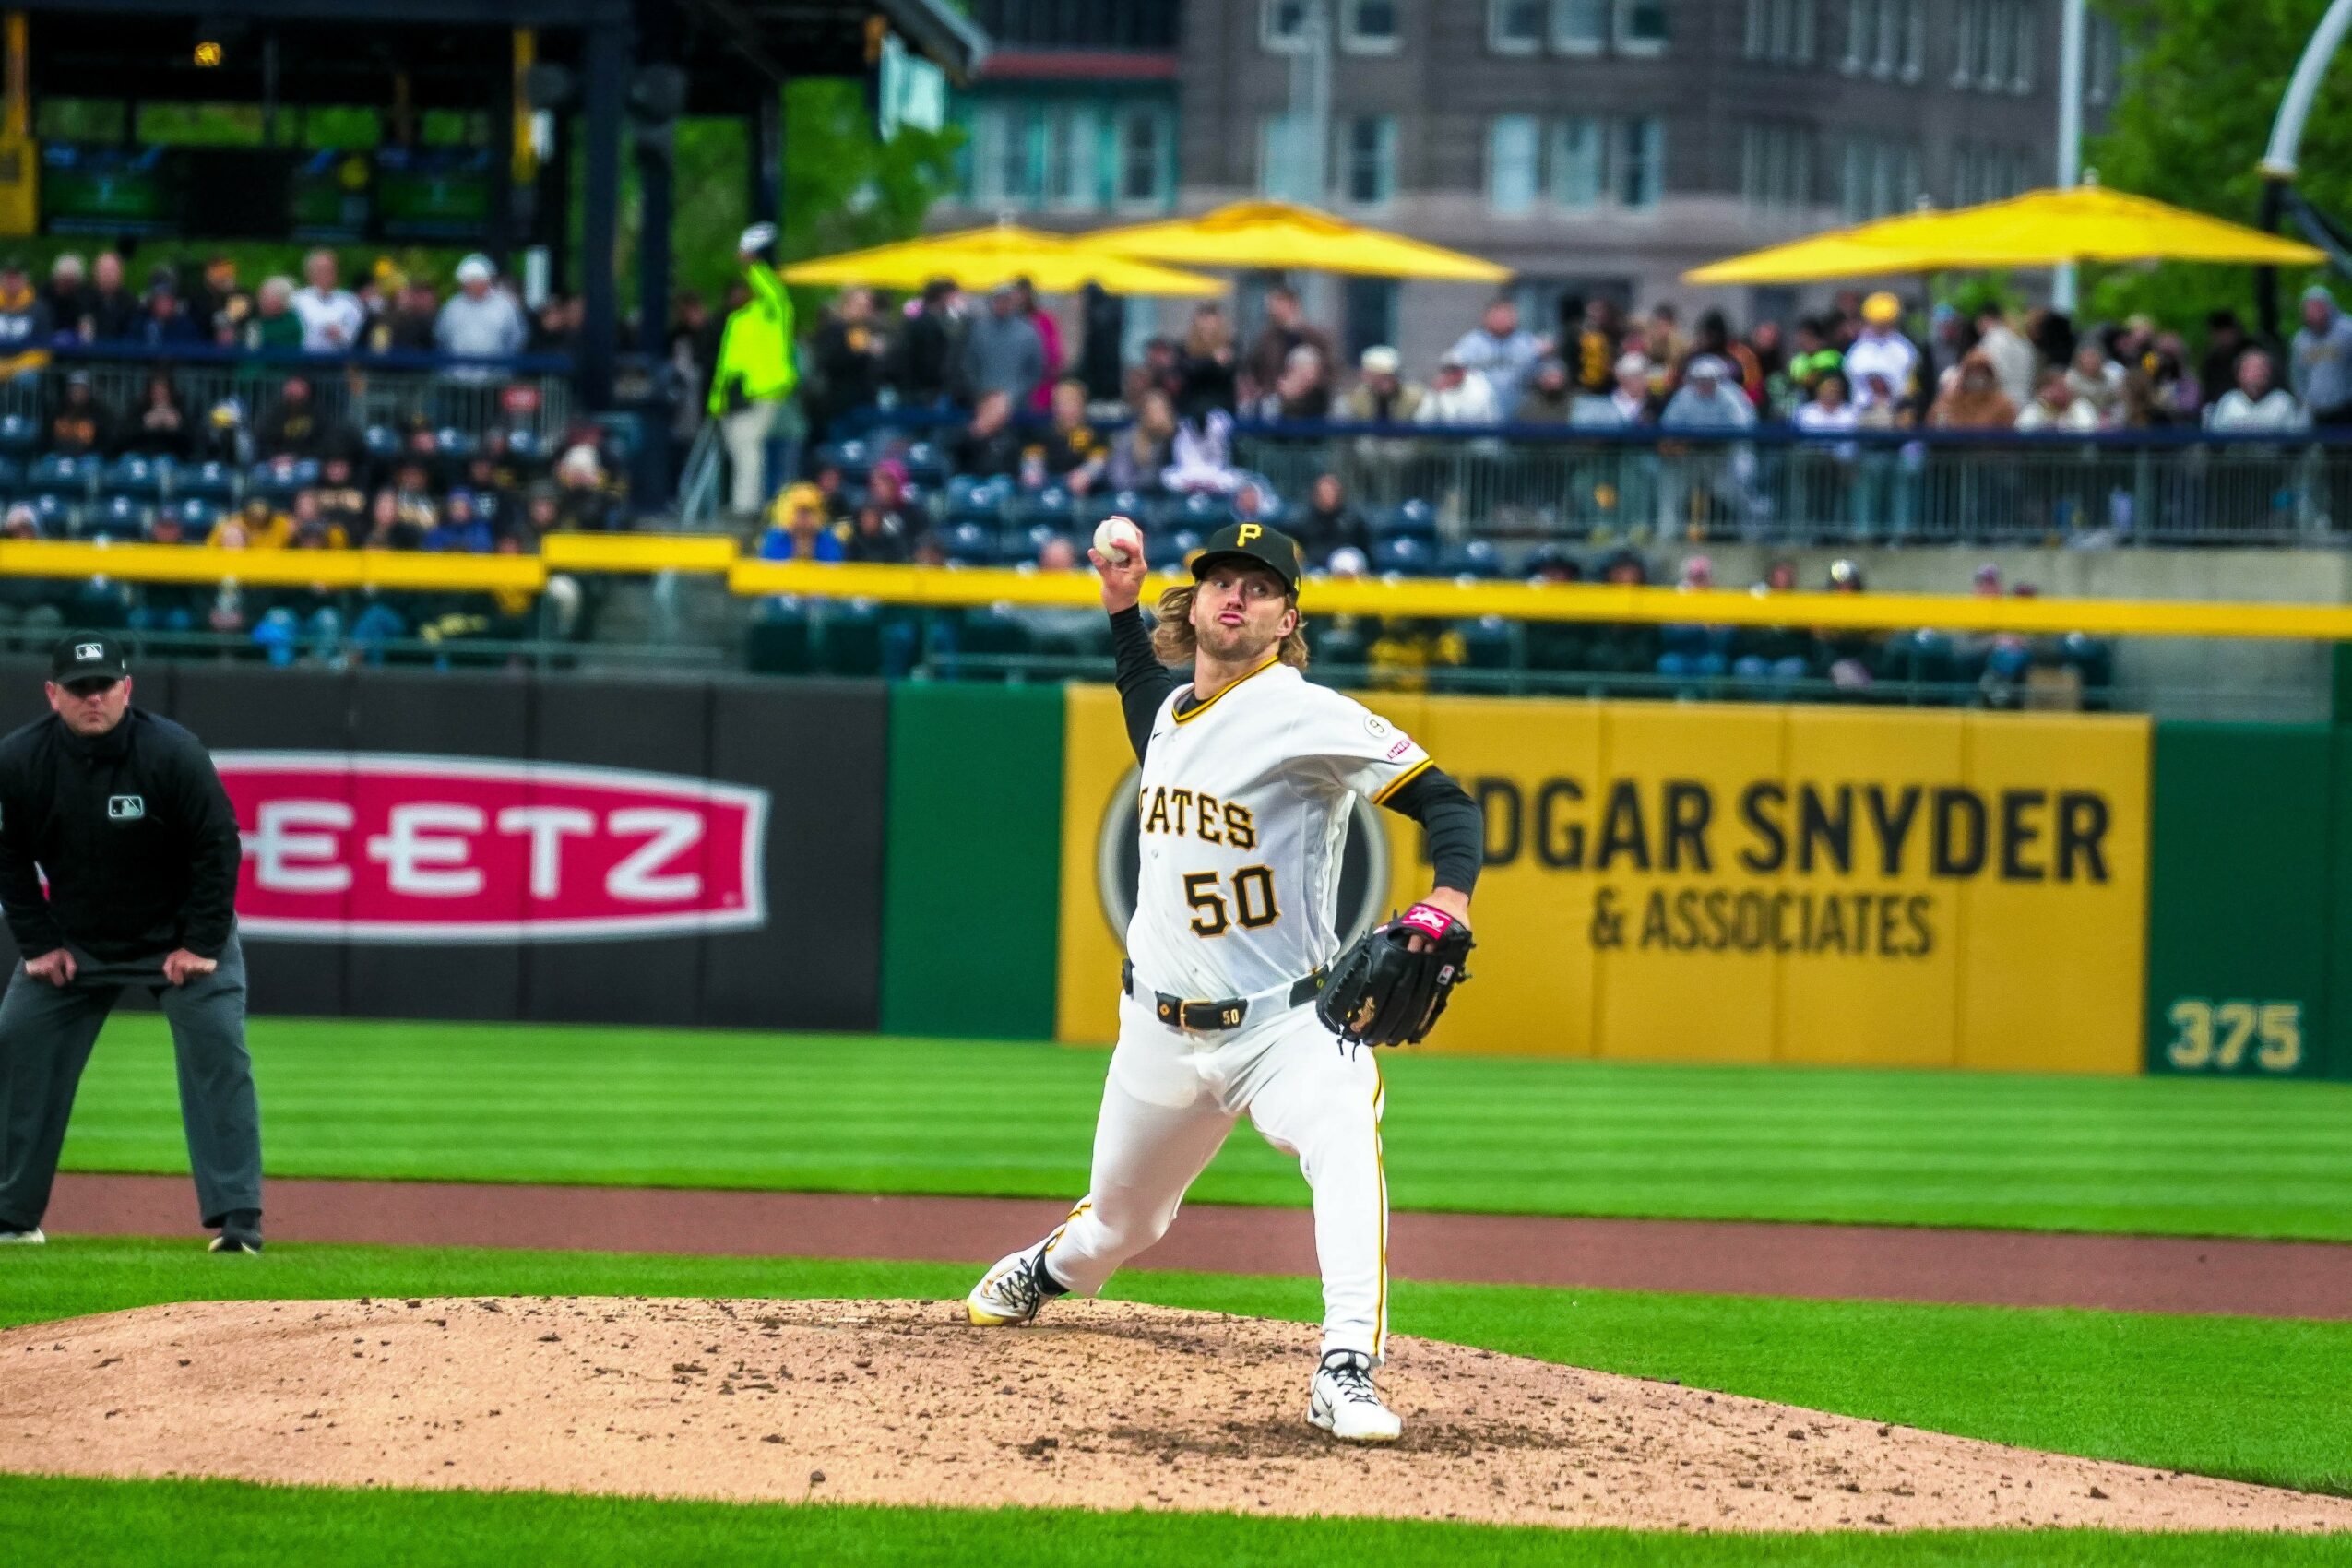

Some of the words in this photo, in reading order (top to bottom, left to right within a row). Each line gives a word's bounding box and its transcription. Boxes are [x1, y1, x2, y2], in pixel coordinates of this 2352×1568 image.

[1237, 523, 1262, 547] P
[1369, 719, 1385, 733] 9
[242, 799, 704, 901] EETZ
[1419, 777, 1712, 872] DGAR
[1739, 779, 2112, 883] SNYDER
[1182, 863, 1281, 939] 50
[1590, 887, 1625, 951] &
[1639, 888, 1935, 959] ASSOCIATES
[1222, 1008, 1240, 1025] 50
[2168, 999, 2302, 1067] 375
